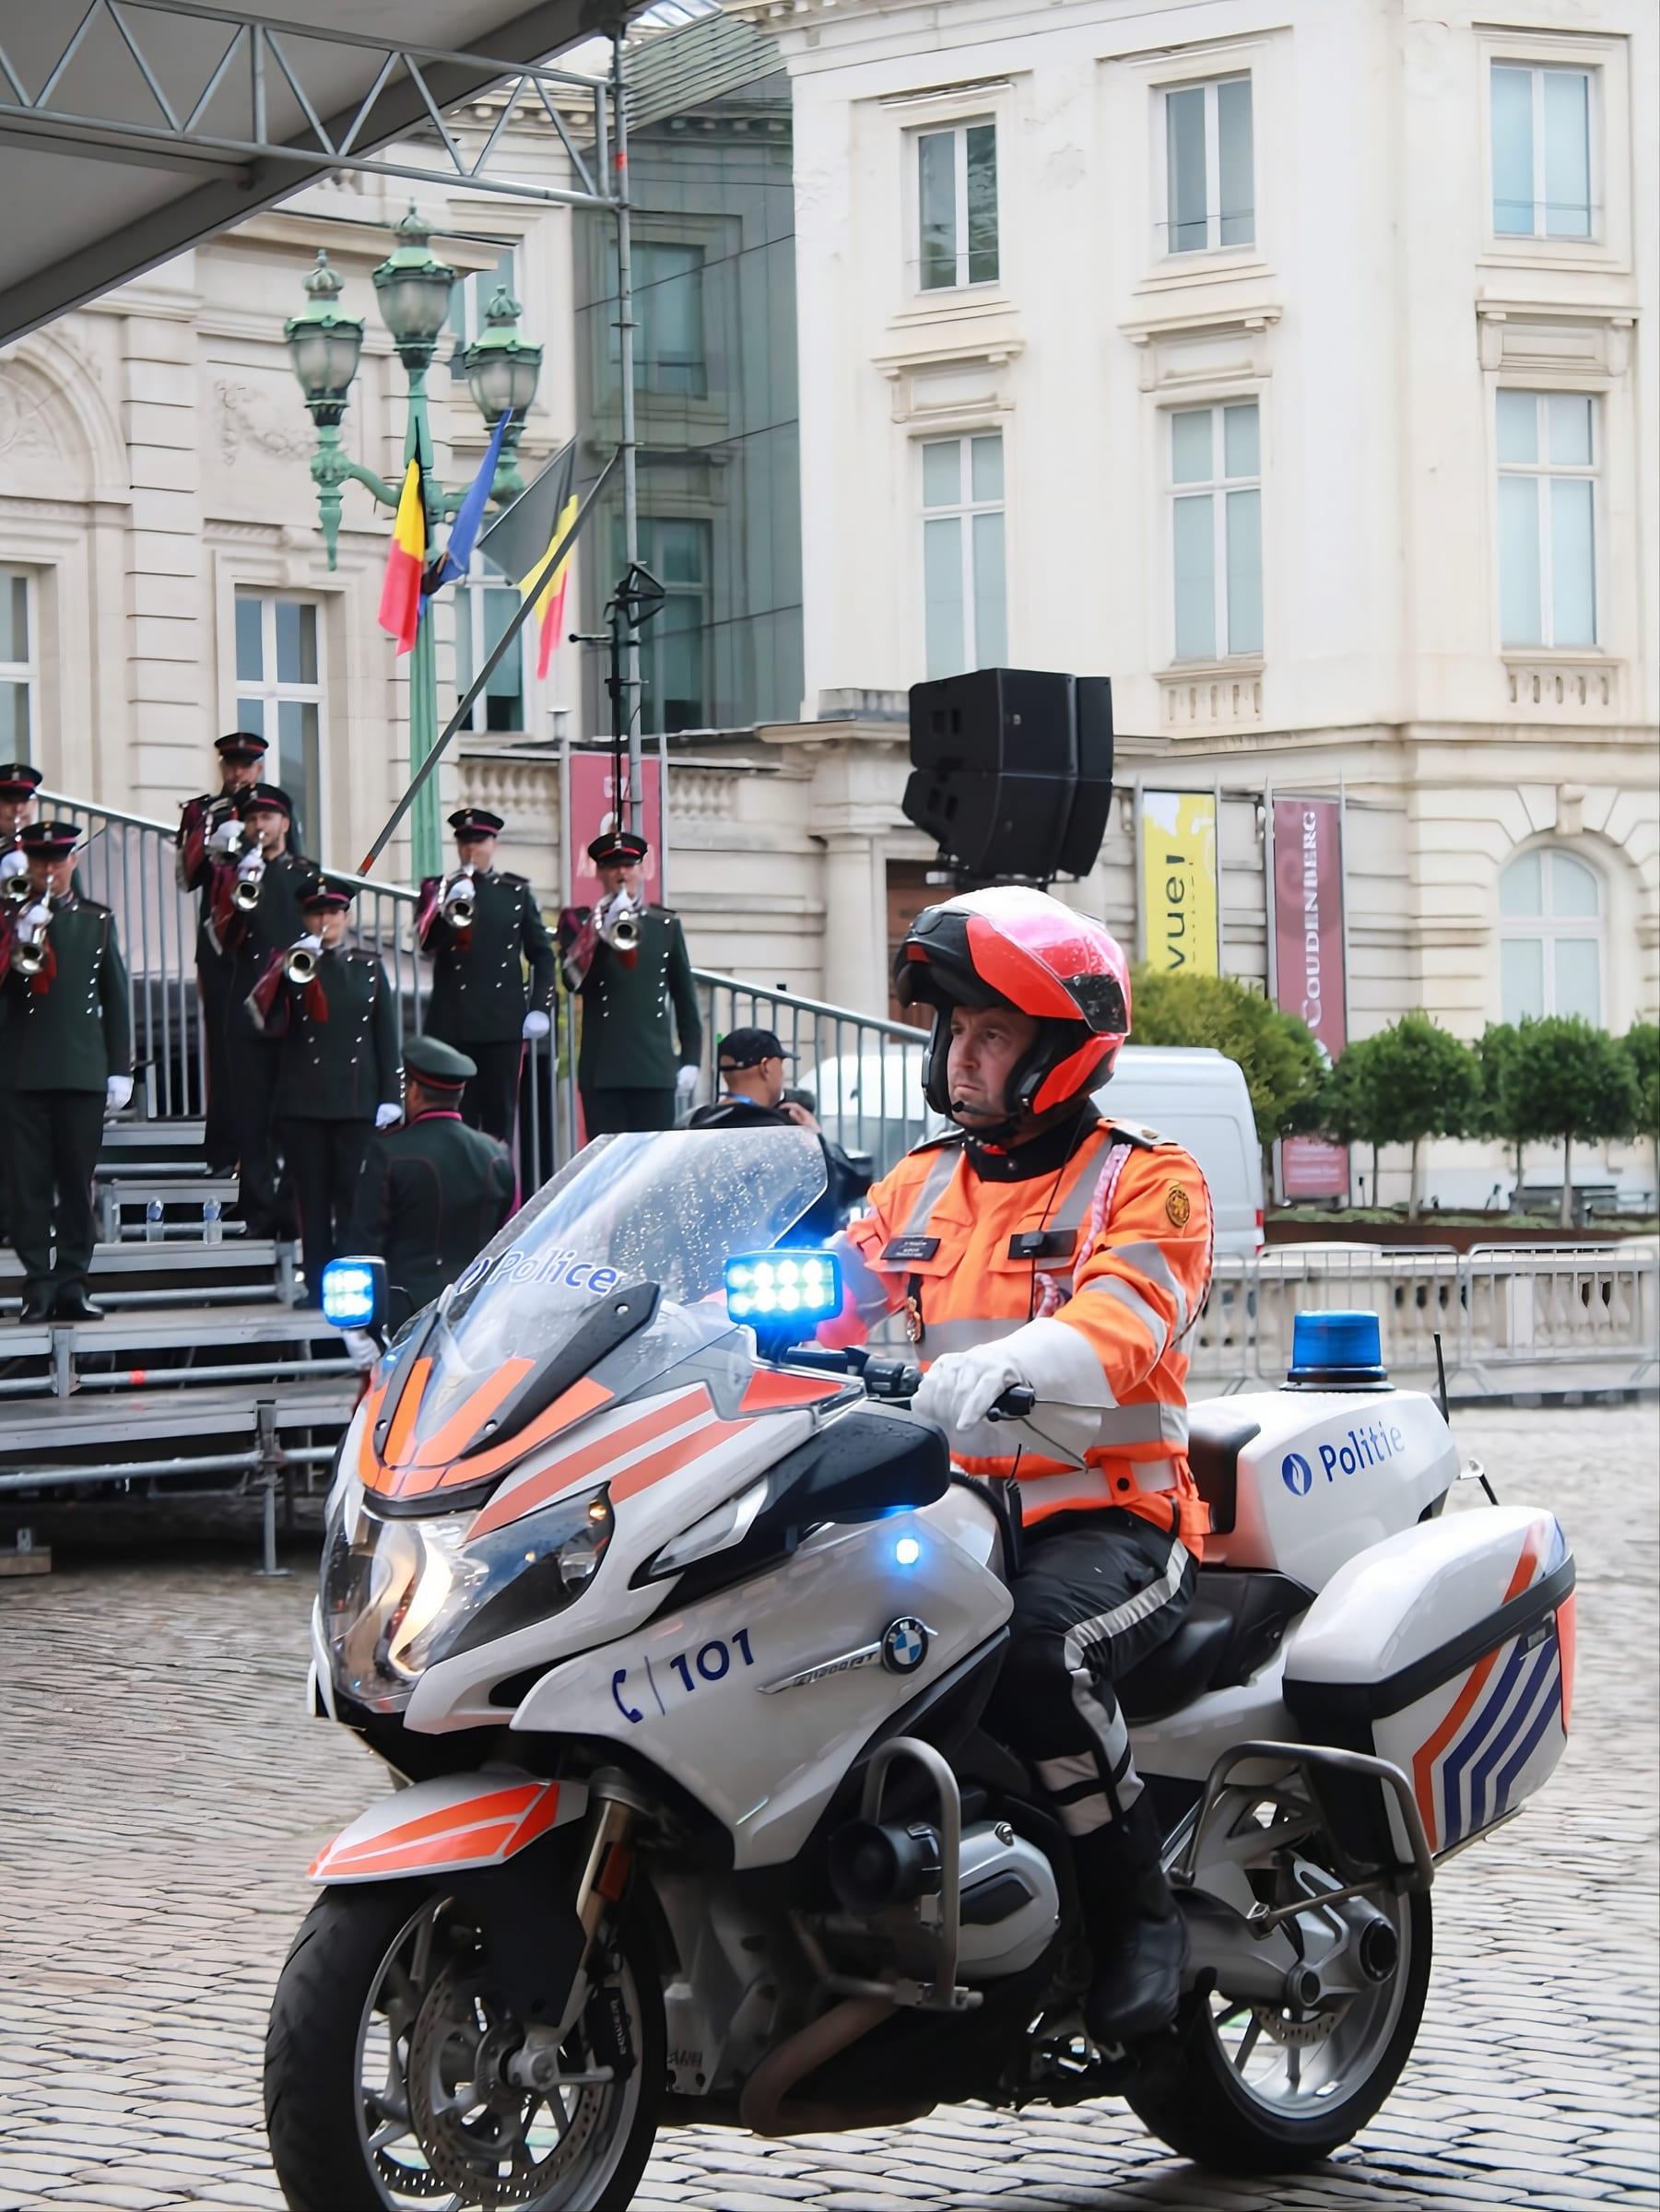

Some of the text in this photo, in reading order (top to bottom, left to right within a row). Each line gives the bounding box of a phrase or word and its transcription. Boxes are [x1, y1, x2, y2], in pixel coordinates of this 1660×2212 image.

[1301, 811, 1322, 1029] COUDENBERG
[490, 1247, 618, 1296] Police
[1318, 1420, 1406, 1482] Politie
[669, 1628, 754, 1692] 101
